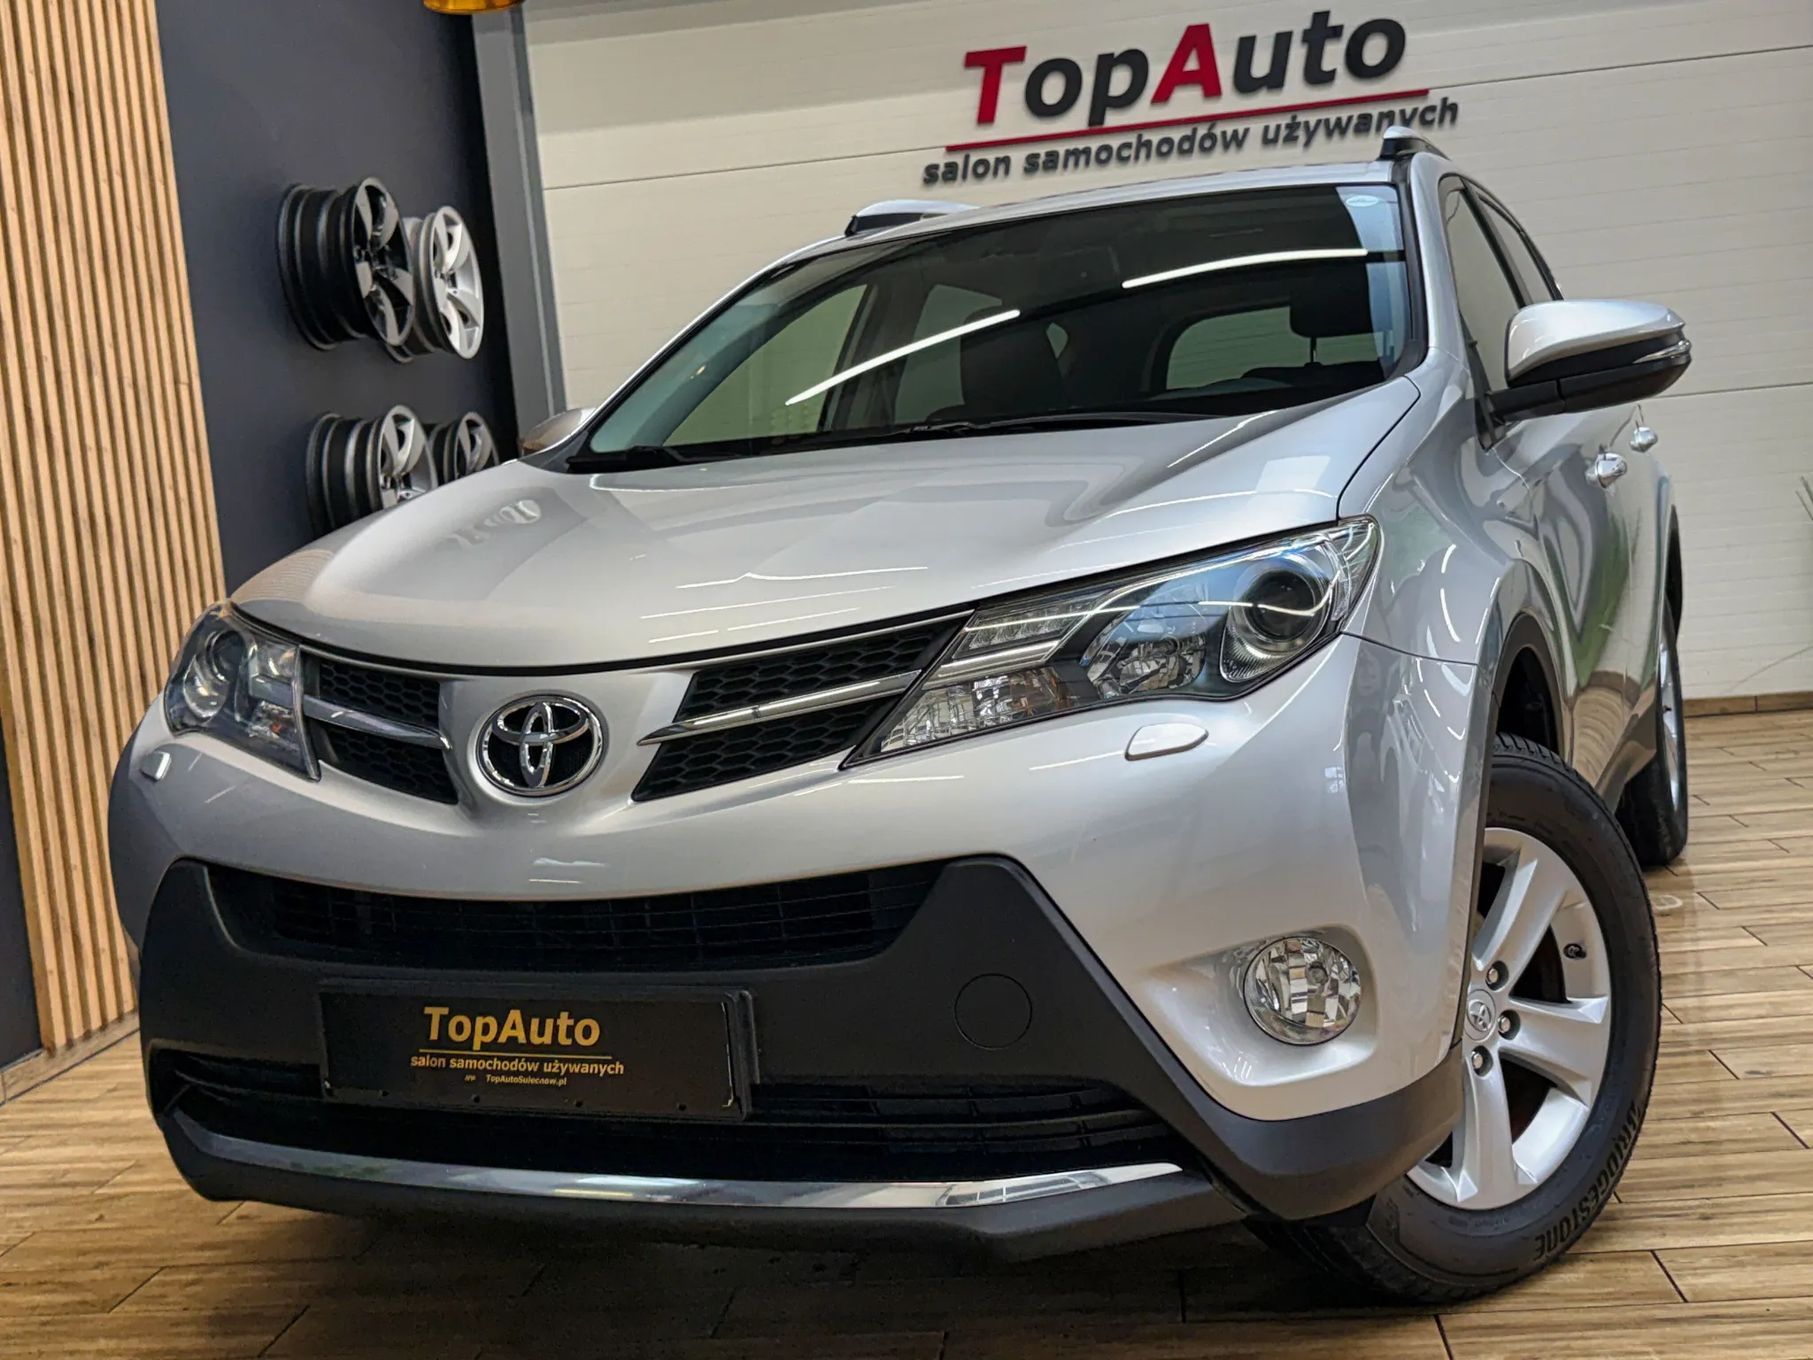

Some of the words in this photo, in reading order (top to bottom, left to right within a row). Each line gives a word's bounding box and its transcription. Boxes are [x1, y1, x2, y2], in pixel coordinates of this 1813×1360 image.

[964, 10, 1406, 127] TopAuto
[923, 152, 1011, 185] salon
[1023, 122, 1251, 174] samochodów
[1262, 98, 1459, 147] używanych
[424, 1006, 600, 1050] TopAuto
[410, 1054, 446, 1068] salon
[450, 1057, 539, 1073] samochodów
[543, 1060, 625, 1077] używanych
